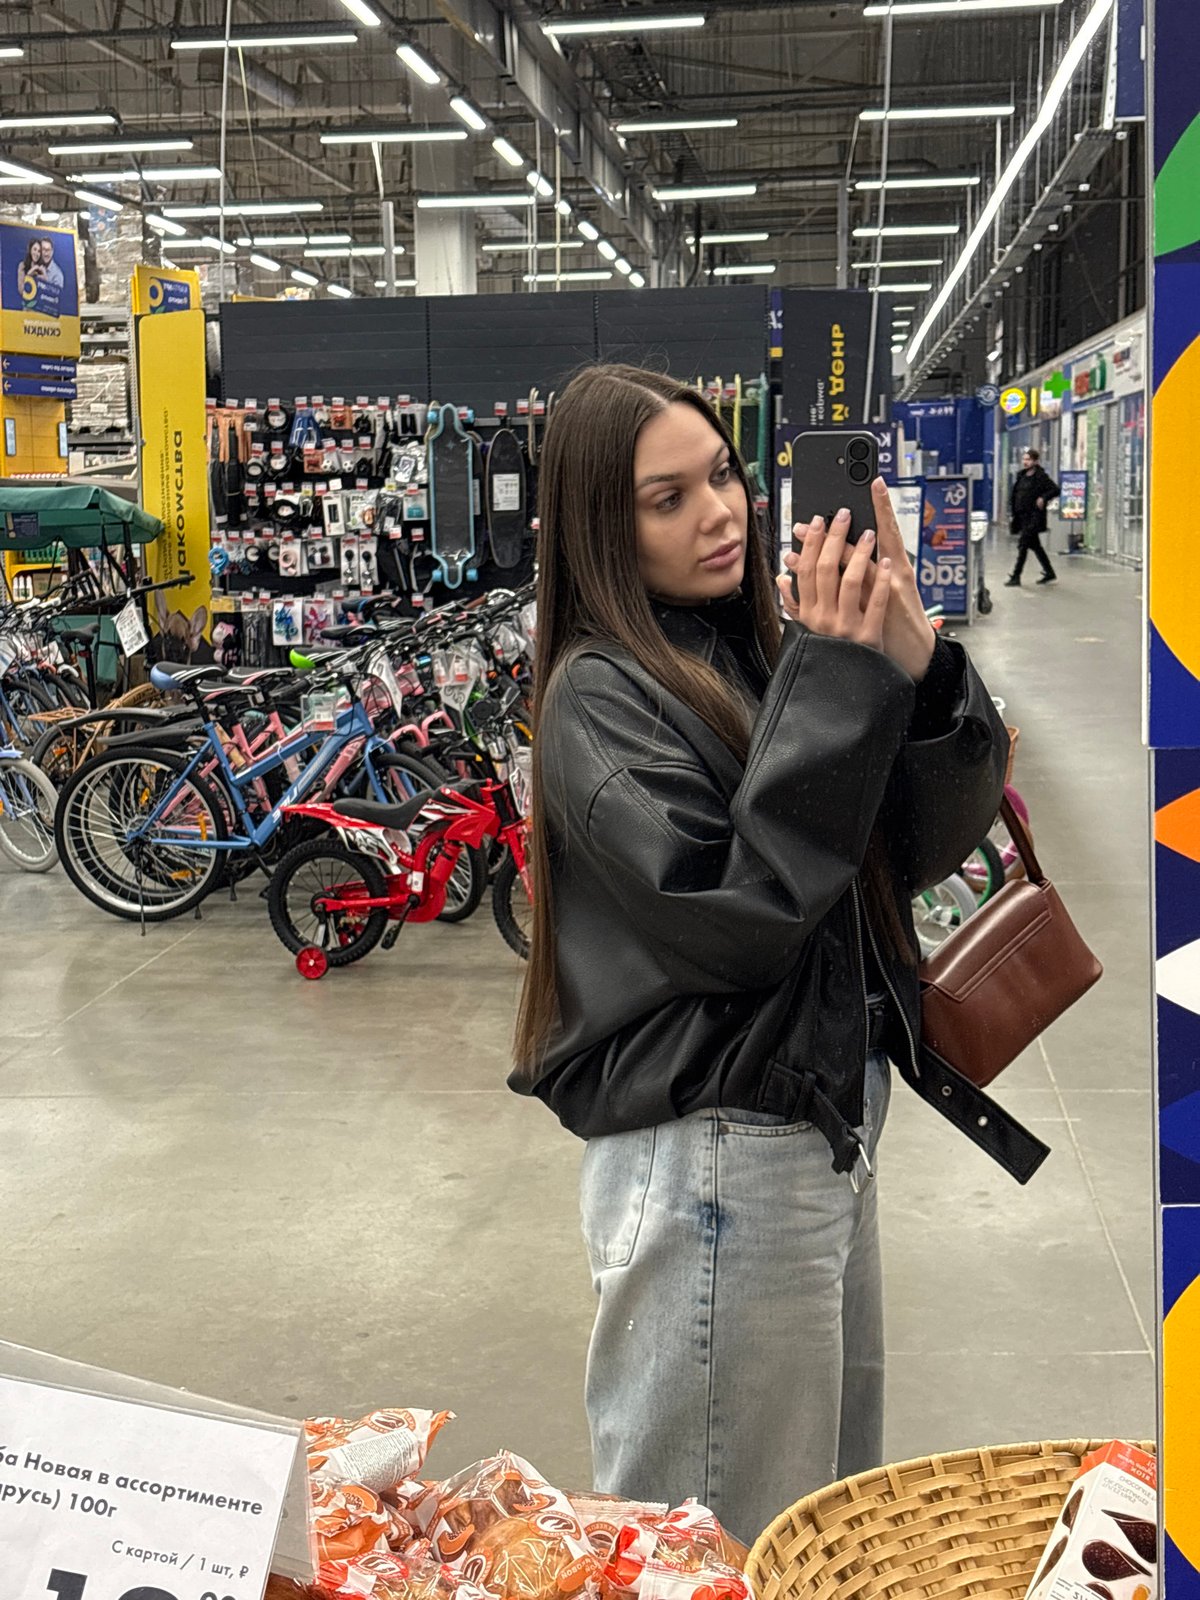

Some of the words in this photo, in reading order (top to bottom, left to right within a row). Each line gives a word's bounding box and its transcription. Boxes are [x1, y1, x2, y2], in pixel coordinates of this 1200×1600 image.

[0, 1483, 61, 1511] русь)
[69, 1493, 118, 1518] 100г
[23, 1451, 93, 1482] Новая
[97, 1472, 110, 1485] в
[115, 1475, 263, 1515] ассортименте
[111, 1540, 124, 1553] С
[126, 1546, 179, 1566] картой
[180, 1553, 195, 1570] /
[200, 1557, 207, 1571] 1
[211, 1563, 234, 1579] шт,
[239, 1565, 249, 1579] ₽
